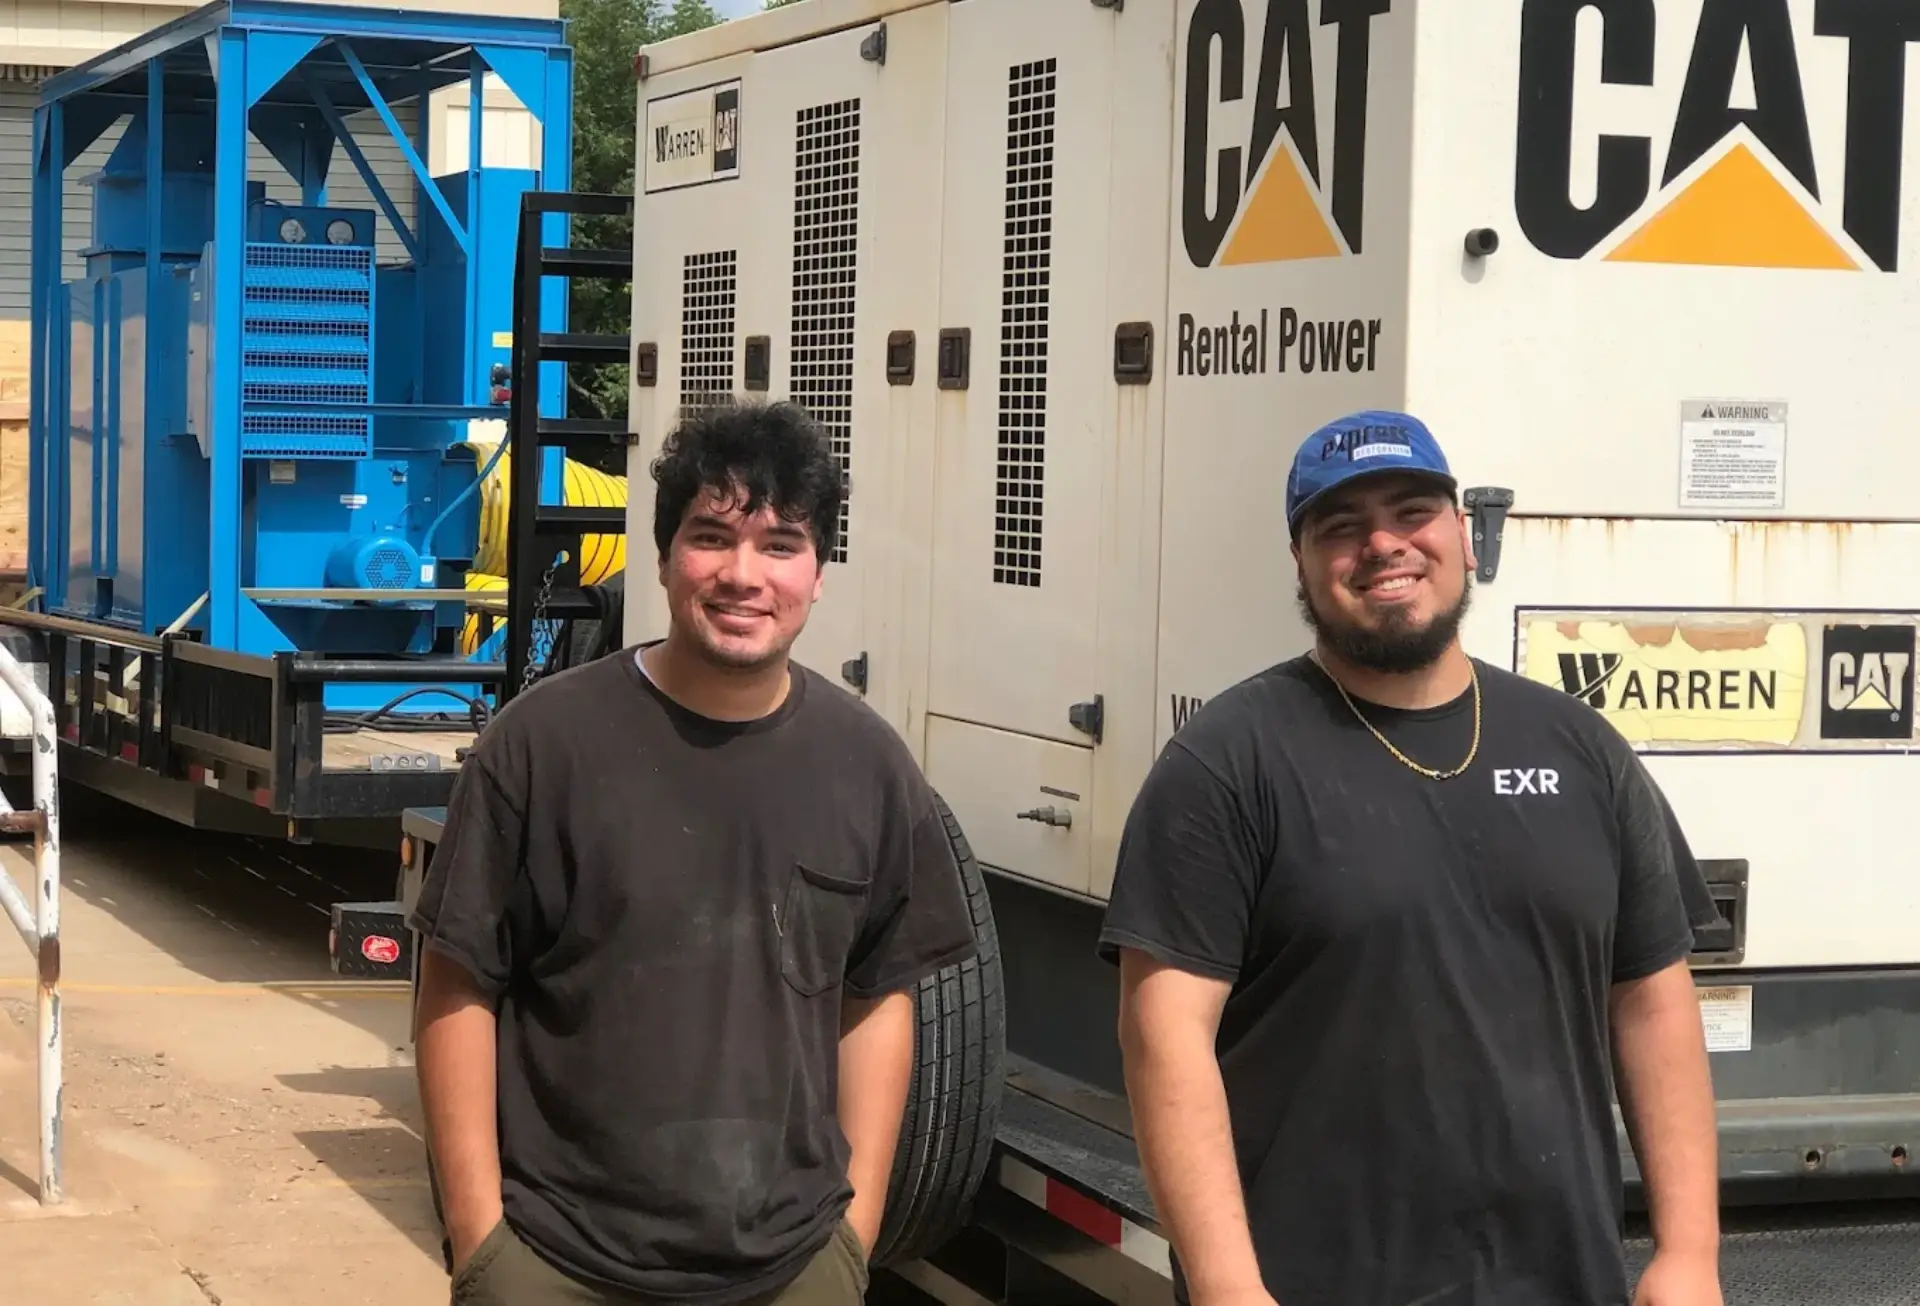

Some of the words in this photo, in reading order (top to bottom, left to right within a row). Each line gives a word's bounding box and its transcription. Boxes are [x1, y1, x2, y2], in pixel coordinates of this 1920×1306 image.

[655, 125, 705, 163] WARREN
[715, 108, 737, 152] CAT
[1182, 0, 1391, 268] CAT
[1514, 0, 1920, 273] CAT
[1177, 309, 1268, 376] Rental
[1279, 307, 1382, 374] Power
[1717, 405, 1769, 419] WARNING
[1556, 653, 1777, 710] WARREN
[1828, 652, 1910, 711] CAT
[1493, 768, 1560, 796] EXR
[1698, 992, 1736, 1001] ARNING
